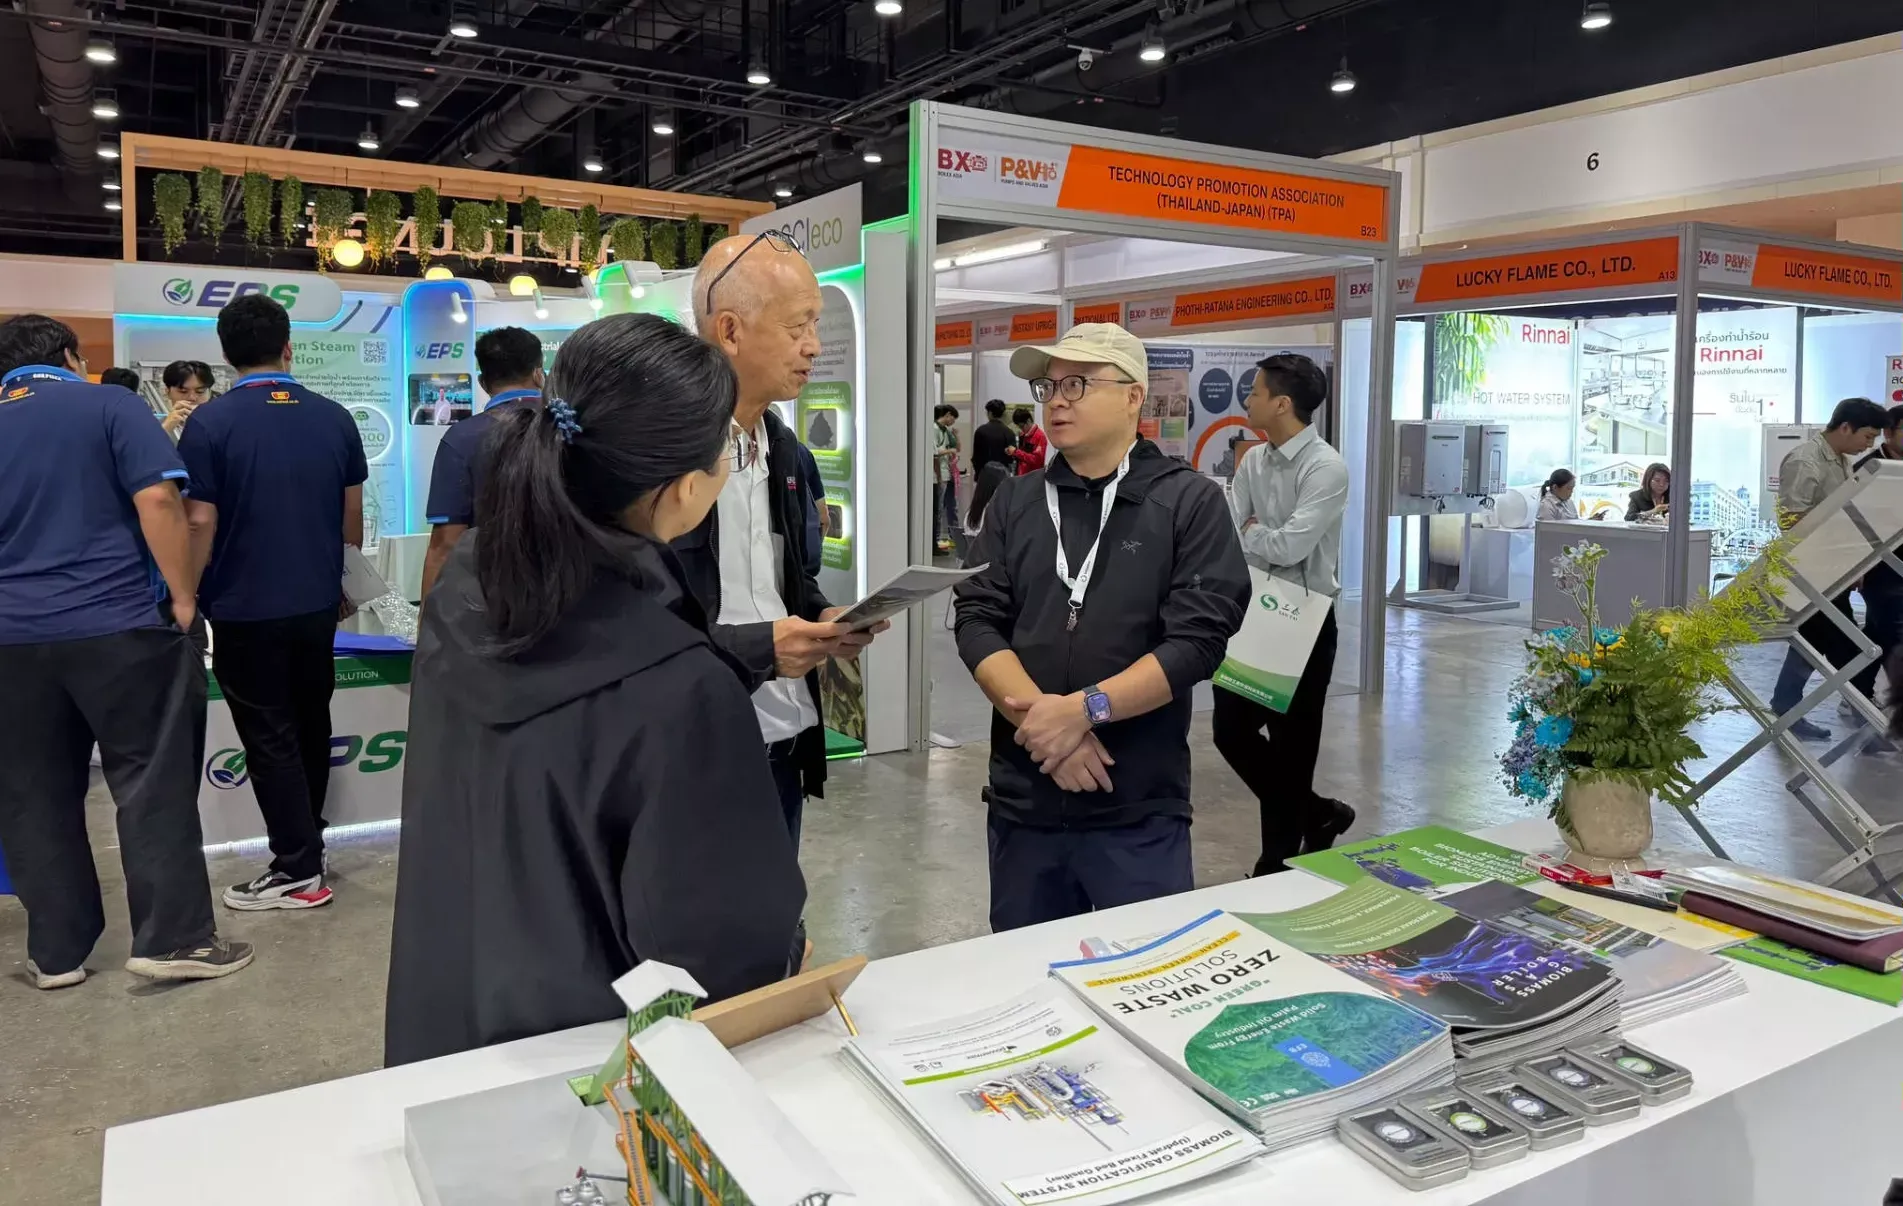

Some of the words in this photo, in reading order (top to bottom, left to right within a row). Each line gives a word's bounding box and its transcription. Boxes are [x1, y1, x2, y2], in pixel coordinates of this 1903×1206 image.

[937, 148, 971, 173] BX
[1586, 152, 1600, 171] 6
[1108, 165, 1194, 190] TECHNOLOGY
[1196, 177, 1268, 199] PROMOTION
[1271, 188, 1345, 208] ASSOCIATION
[1157, 194, 1265, 220] (THAILAND-JAPAN)
[1267, 206, 1296, 223] (TPA)
[1361, 225, 1377, 237] B23
[1456, 268, 1503, 288] LUCKY
[1507, 263, 1558, 283] FLAME
[1563, 260, 1596, 278] CO.,
[1602, 256, 1636, 273] LTD.
[1658, 271, 1676, 281] A13
[1784, 261, 1817, 280] LUCKY
[1820, 266, 1850, 284] FLAME
[1854, 270, 1872, 289] CO.,
[1874, 272, 1893, 289] LTD.
[1175, 301, 1234, 318] PHOTHI-RATANA
[1236, 294, 1293, 311] ENGINEERING
[1315, 288, 1333, 301] LTD.
[1521, 324, 1570, 344] Rinnai
[311, 341, 355, 353] Steam
[427, 342, 465, 359] EPS
[1700, 345, 1763, 362] Rinnai
[294, 355, 324, 368] tion
[1472, 391, 1493, 405] HOT
[1497, 392, 1531, 405] WATER
[1534, 393, 1570, 406] SYSTEM
[335, 670, 379, 682] OLUTION
[329, 730, 408, 774] PS
[1120, 949, 1238, 996] SOLUTIONS
[1210, 948, 1281, 986] ZERO
[1491, 956, 1549, 986] BOILER
[1516, 966, 1573, 998] BIOMASS
[1112, 981, 1209, 1015] WASTE
[1257, 1014, 1273, 1025] Oil
[1273, 1004, 1299, 1019] Palm
[1300, 1002, 1327, 1019] Solid
[1214, 1021, 1257, 1040] Industry
[1270, 1014, 1301, 1031] Waste
[1207, 1037, 1234, 1050] From
[1234, 1026, 1270, 1043] Energy
[1148, 1136, 1192, 1157] (Updraft
[1174, 1129, 1234, 1158] BIOMASS
[1094, 1161, 1117, 1174] Bed
[1116, 1150, 1149, 1167] Fixed
[1045, 1168, 1093, 1185] Gasifier)
[1077, 1153, 1173, 1187] GASIFICATION
[1016, 1180, 1076, 1200] SYSTEM
